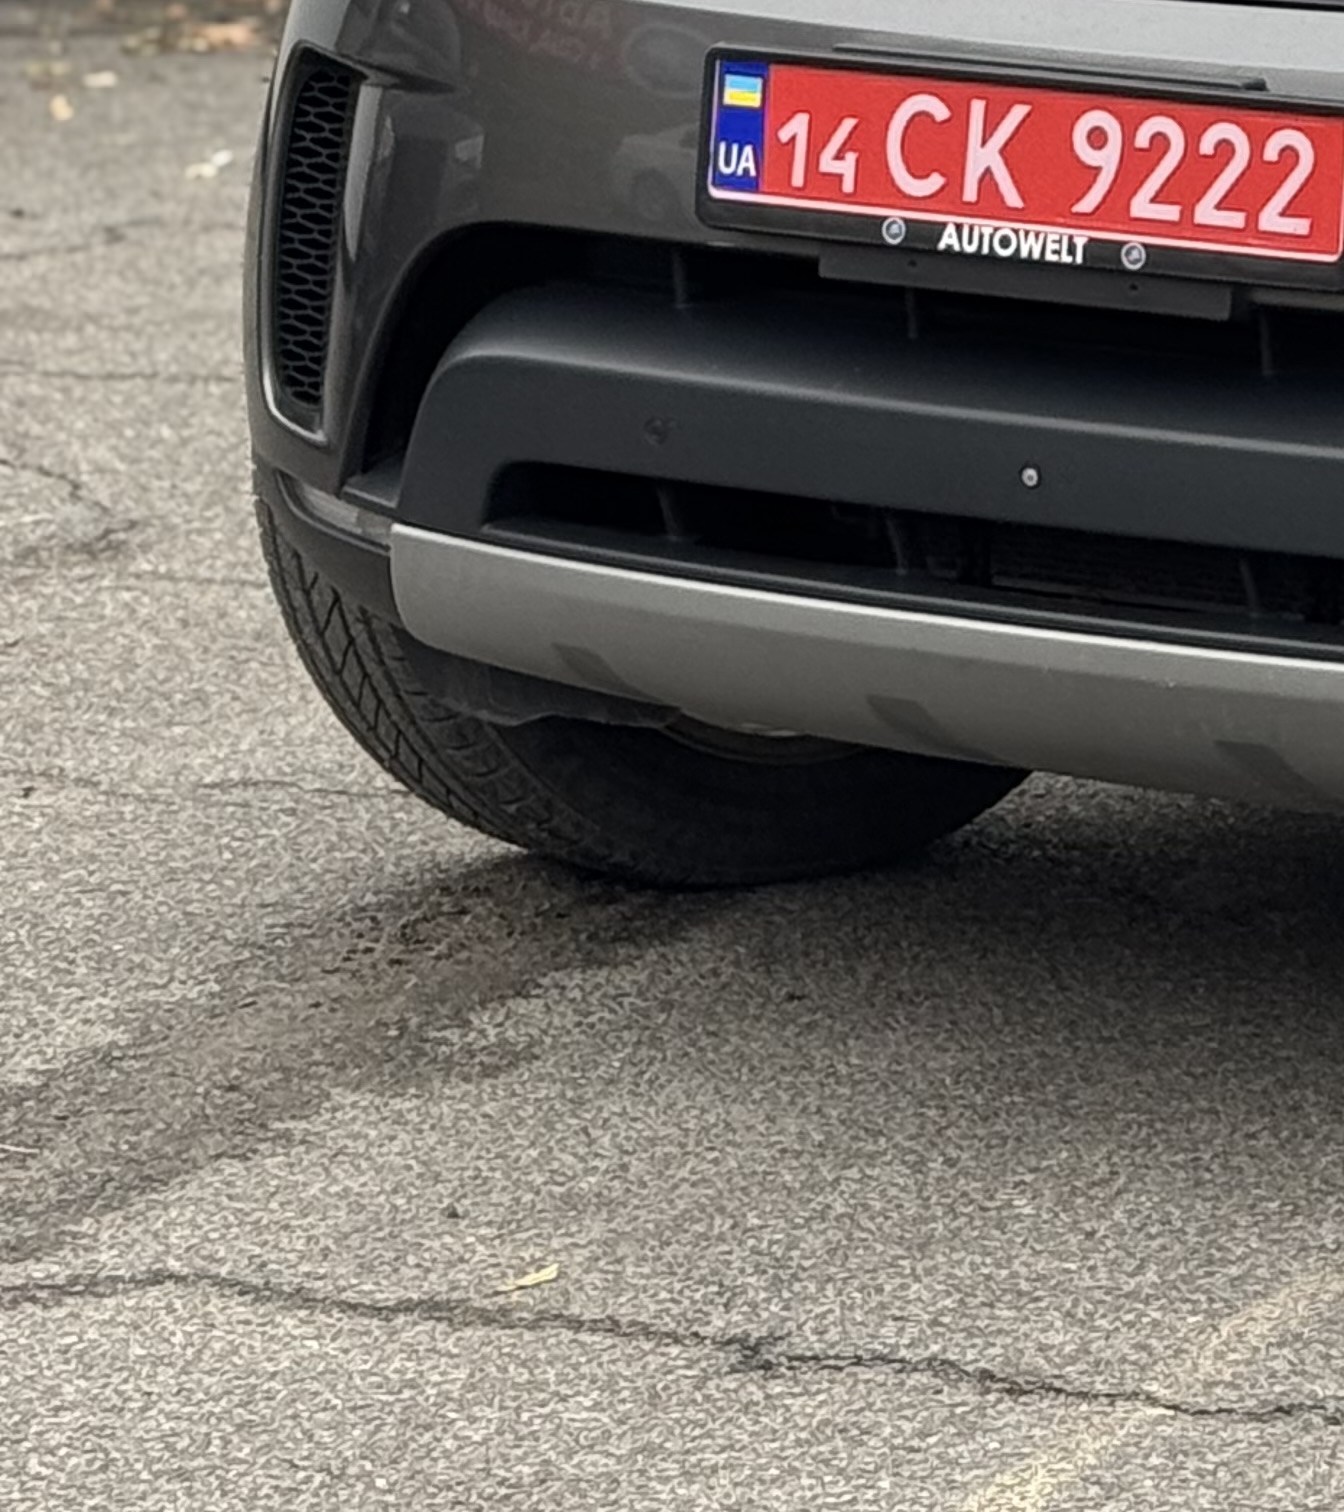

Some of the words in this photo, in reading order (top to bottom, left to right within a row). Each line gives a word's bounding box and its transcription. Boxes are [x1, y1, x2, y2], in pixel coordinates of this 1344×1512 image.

[717, 140, 757, 177] UA
[776, 112, 860, 194] 14
[886, 92, 1033, 209] CK
[1071, 109, 1316, 237] 9222
[937, 222, 1090, 265] AUTOWELT
